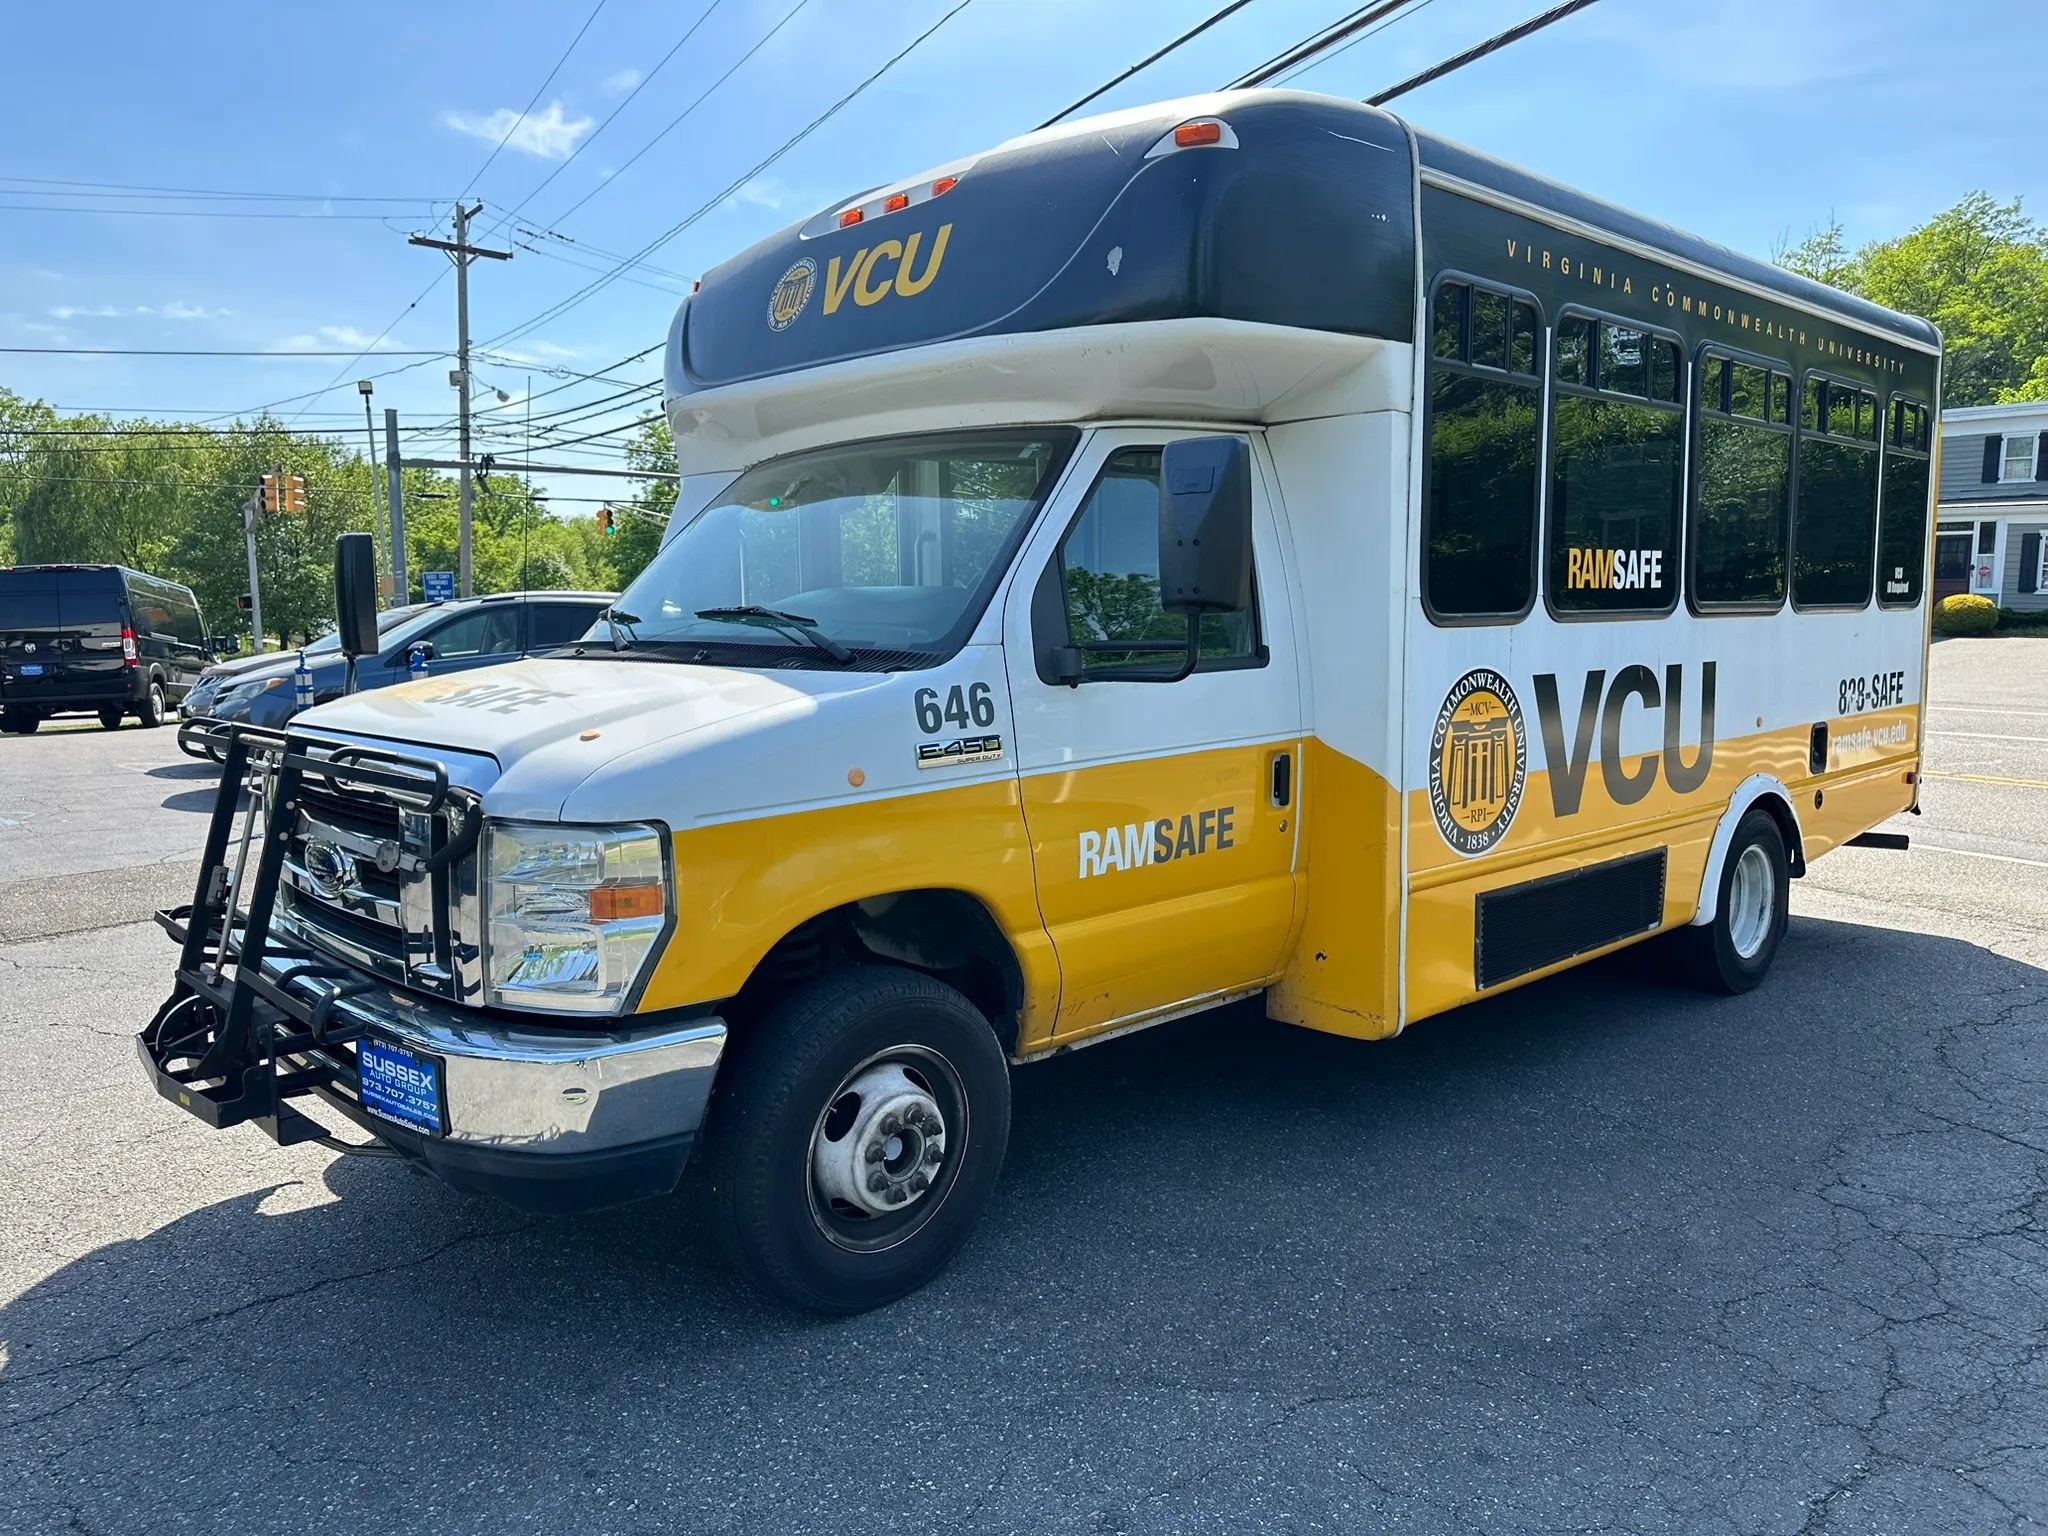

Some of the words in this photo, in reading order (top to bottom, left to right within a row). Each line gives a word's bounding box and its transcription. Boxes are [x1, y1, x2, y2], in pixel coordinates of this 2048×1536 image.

[823, 223, 953, 316] VCU
[1507, 239, 1632, 294] VIRGINIA
[1652, 286, 1805, 345] COMMONWEALTH
[1818, 337, 1905, 374] UNIVERSITY
[1567, 548, 1662, 589] RAMSAFE
[914, 682, 995, 734] 646
[1433, 672, 1518, 749] COMMONWEALTH
[1469, 701, 1492, 716] MCV
[1532, 661, 1716, 818] VCU
[1832, 720, 1906, 755] ramsafe.vcu.edu
[1497, 717, 1525, 834] UNIVERSITY
[1431, 755, 1458, 843] VIRGINIA
[1470, 807, 1487, 823] RPI
[1079, 806, 1234, 879] RAMSAFE
[1466, 831, 1489, 850] 1838
[362, 1051, 434, 1091] SUSSEX
[369, 1069, 392, 1083] AUTO
[394, 1078, 427, 1096] GROUP
[362, 1077, 437, 1112] 973.707.3757
